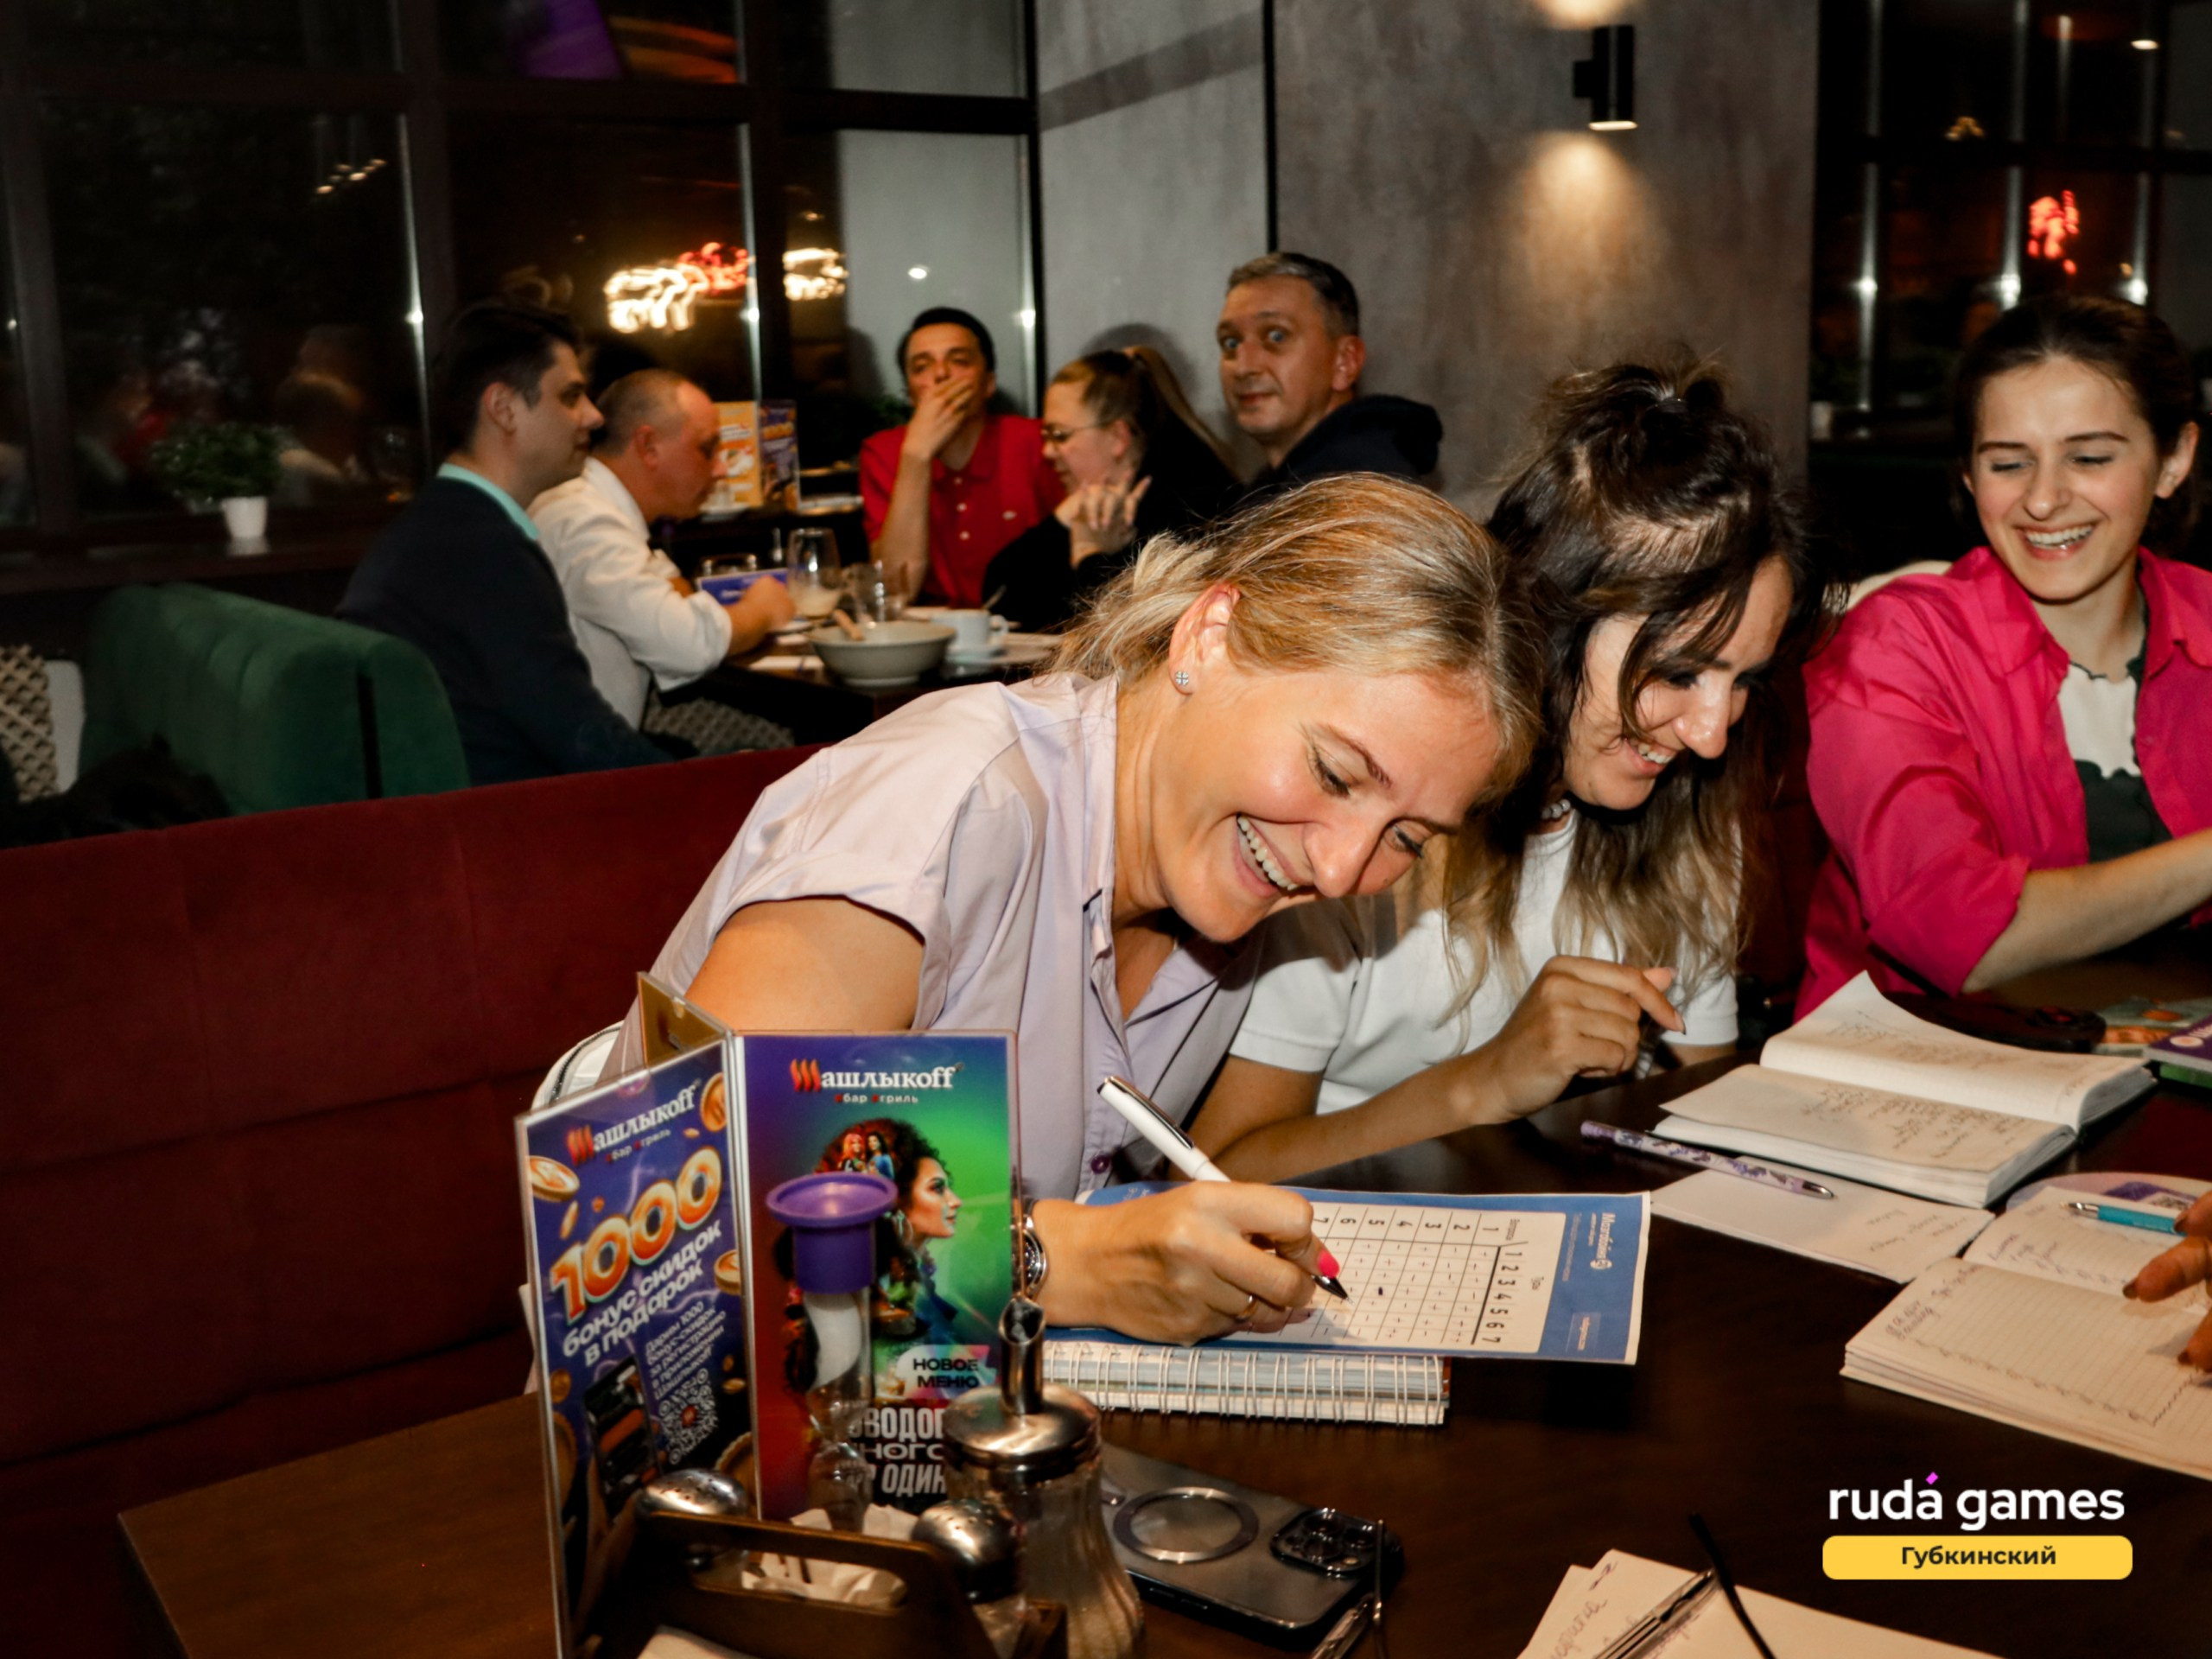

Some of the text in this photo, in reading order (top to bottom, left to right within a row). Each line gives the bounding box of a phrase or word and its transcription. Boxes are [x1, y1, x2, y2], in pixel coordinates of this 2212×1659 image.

[550, 1146, 723, 1325] 1000
[563, 1220, 721, 1357] бонус скидок
[602, 1259, 703, 1352] подарок
[913, 1358, 978, 1371] НОВОЕ
[918, 1376, 980, 1388] МЕНЮ
